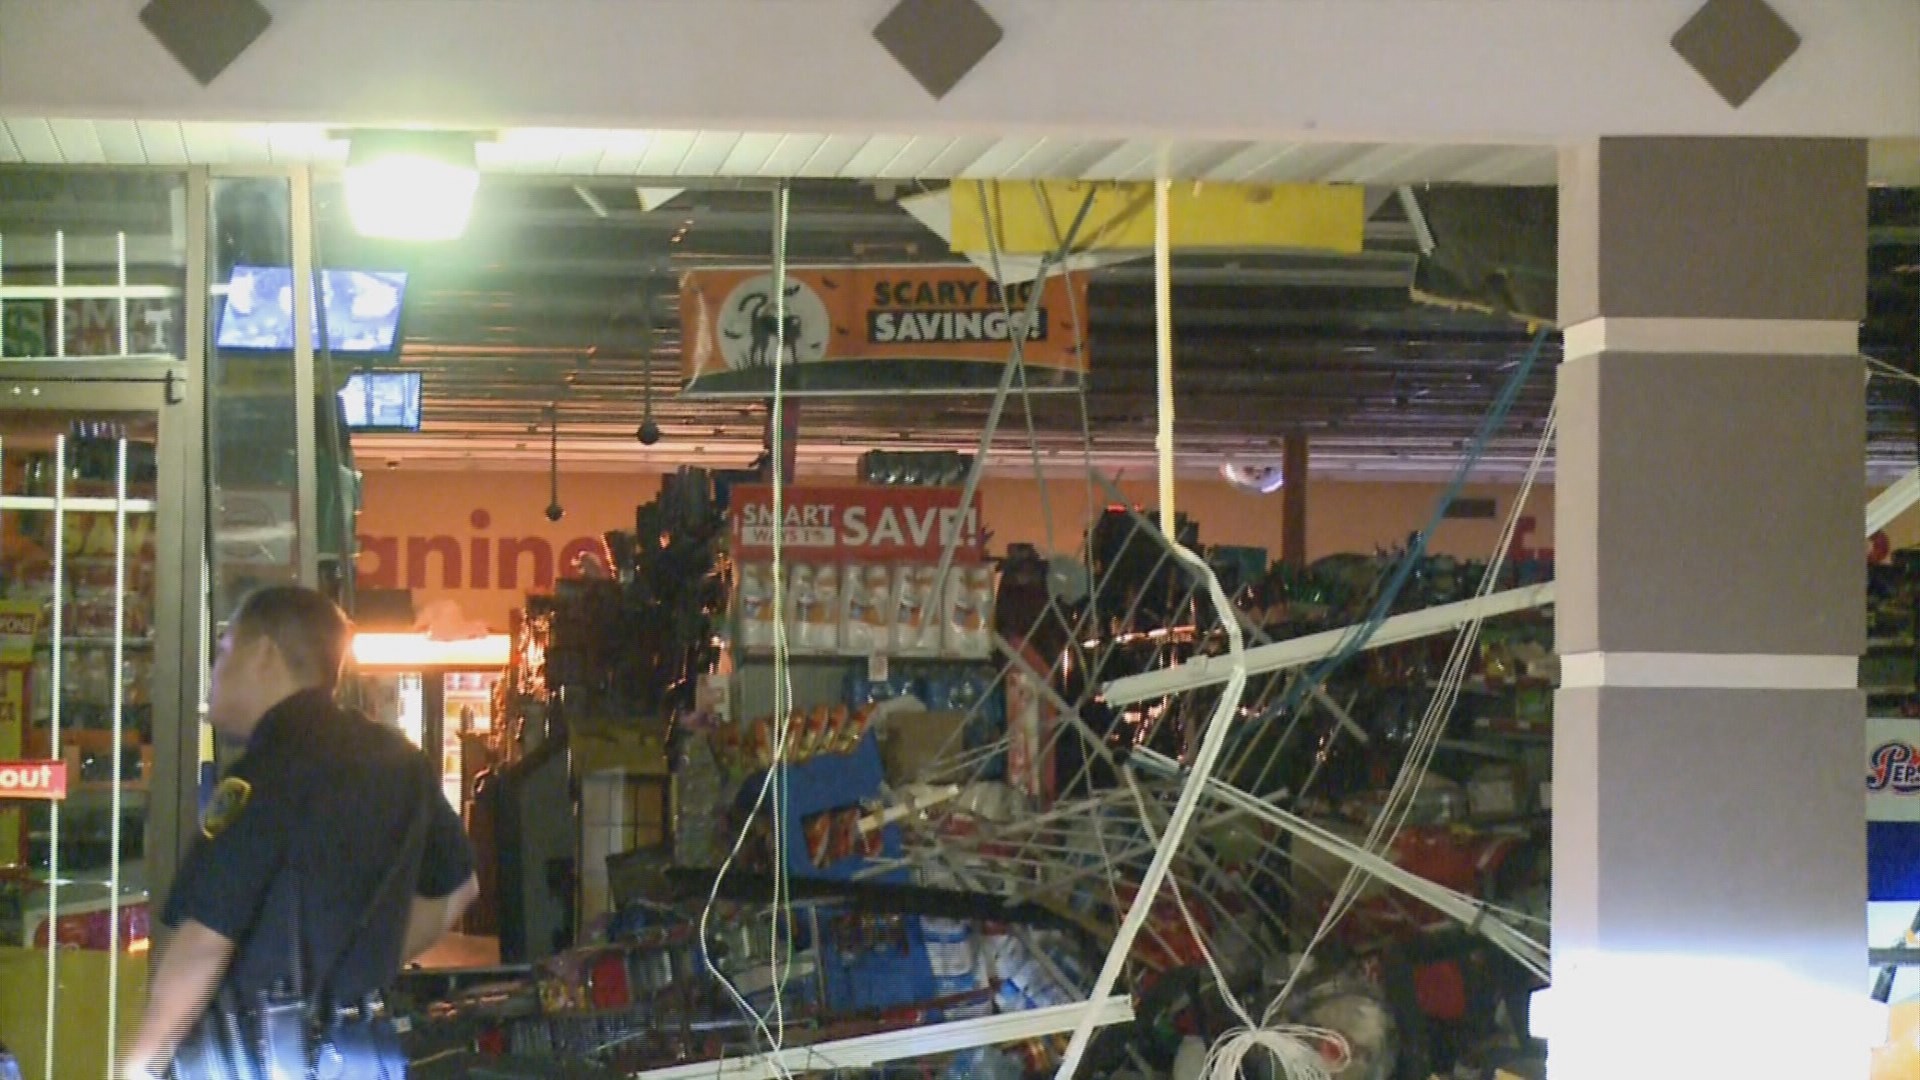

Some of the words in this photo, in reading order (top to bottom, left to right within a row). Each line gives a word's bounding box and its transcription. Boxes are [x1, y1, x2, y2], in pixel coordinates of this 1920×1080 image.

[874, 280, 979, 305] SCARY
[743, 503, 835, 527] SMART
[1866, 742, 1920, 792] PEP
